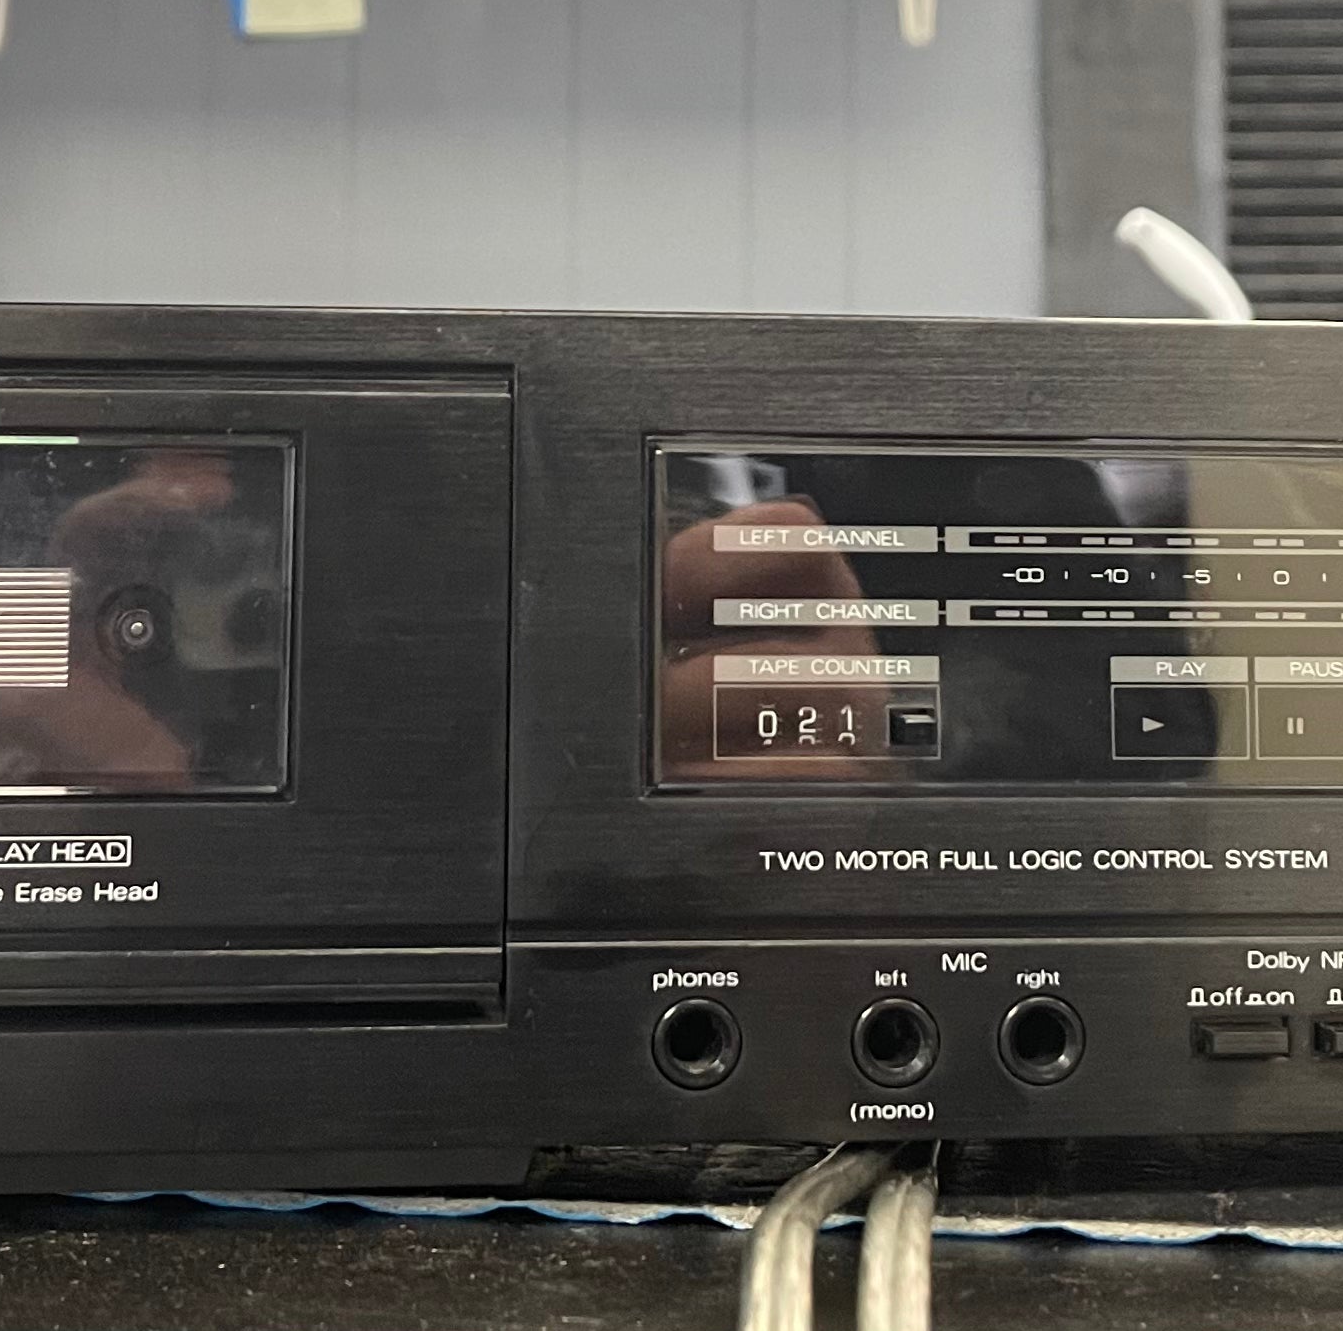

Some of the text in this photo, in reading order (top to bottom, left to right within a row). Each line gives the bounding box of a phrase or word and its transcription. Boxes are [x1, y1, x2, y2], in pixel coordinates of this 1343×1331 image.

[739, 527, 905, 547] LEFT CHANNEL
[1090, 568, 1129, 584] -10
[1182, 569, 1211, 585] -5
[1273, 570, 1290, 585] 0
[739, 602, 917, 621] RIGHT CHANNEL
[748, 658, 911, 676] TAPE COUNTER
[1156, 661, 1207, 677] PLAY
[51, 842, 125, 861] HEAD
[758, 849, 1328, 871] TWO MOTOR FULL LOGIC CONTROL SYSTEM
[15, 882, 83, 903] Erase
[93, 880, 159, 902] Head
[941, 952, 988, 973] MIC
[1247, 950, 1310, 974] Dolby
[652, 968, 739, 992] phones
[875, 969, 908, 987] left
[1016, 969, 1060, 989] right
[850, 1101, 934, 1123] (mono)
